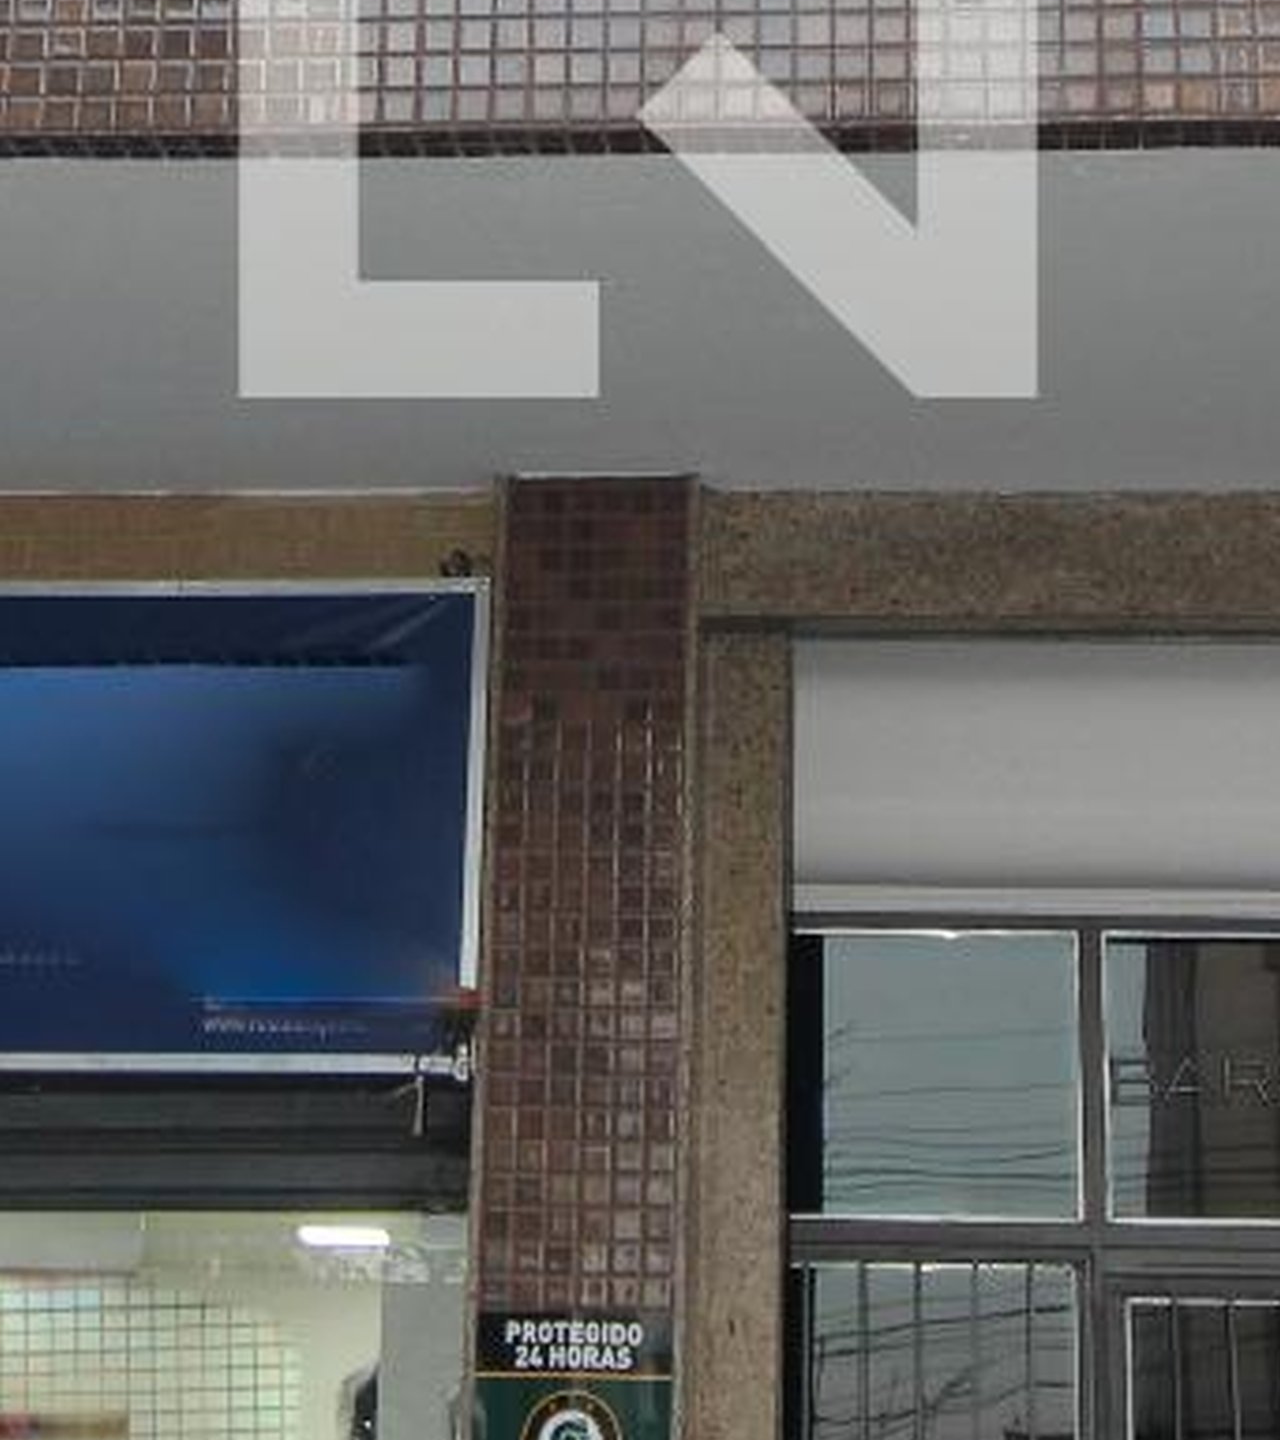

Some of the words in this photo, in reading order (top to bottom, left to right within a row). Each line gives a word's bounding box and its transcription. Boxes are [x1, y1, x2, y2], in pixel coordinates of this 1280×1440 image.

[505, 1320, 644, 1347] PROTEGIDO
[515, 1346, 544, 1368] 24
[549, 1346, 633, 1370] HORAS
